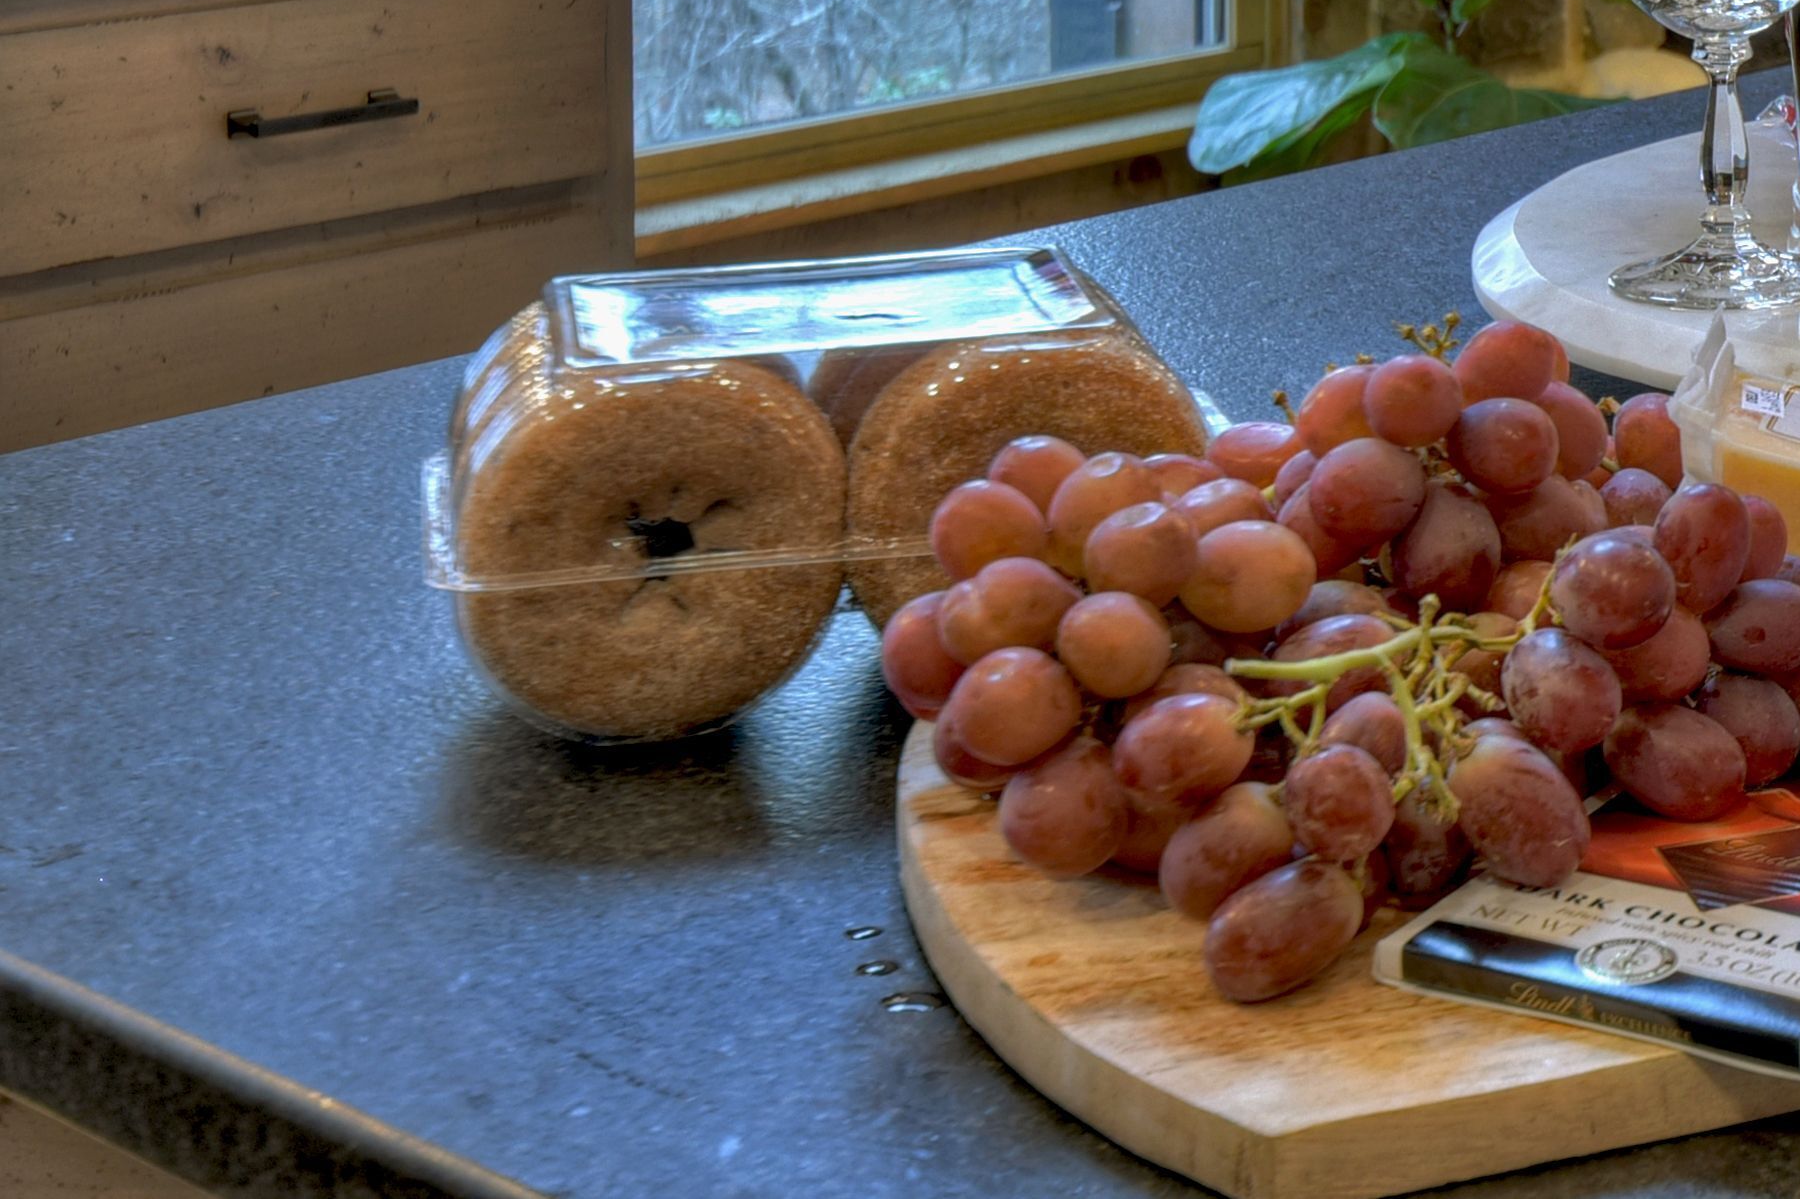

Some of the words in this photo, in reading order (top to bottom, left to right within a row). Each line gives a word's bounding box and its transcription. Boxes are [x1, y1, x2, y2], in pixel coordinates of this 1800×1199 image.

[1472, 903, 1530, 926] NET
[1541, 917, 1585, 937] WT
[1729, 958, 1774, 979] OZ
[1505, 981, 1577, 1015] Lindt
